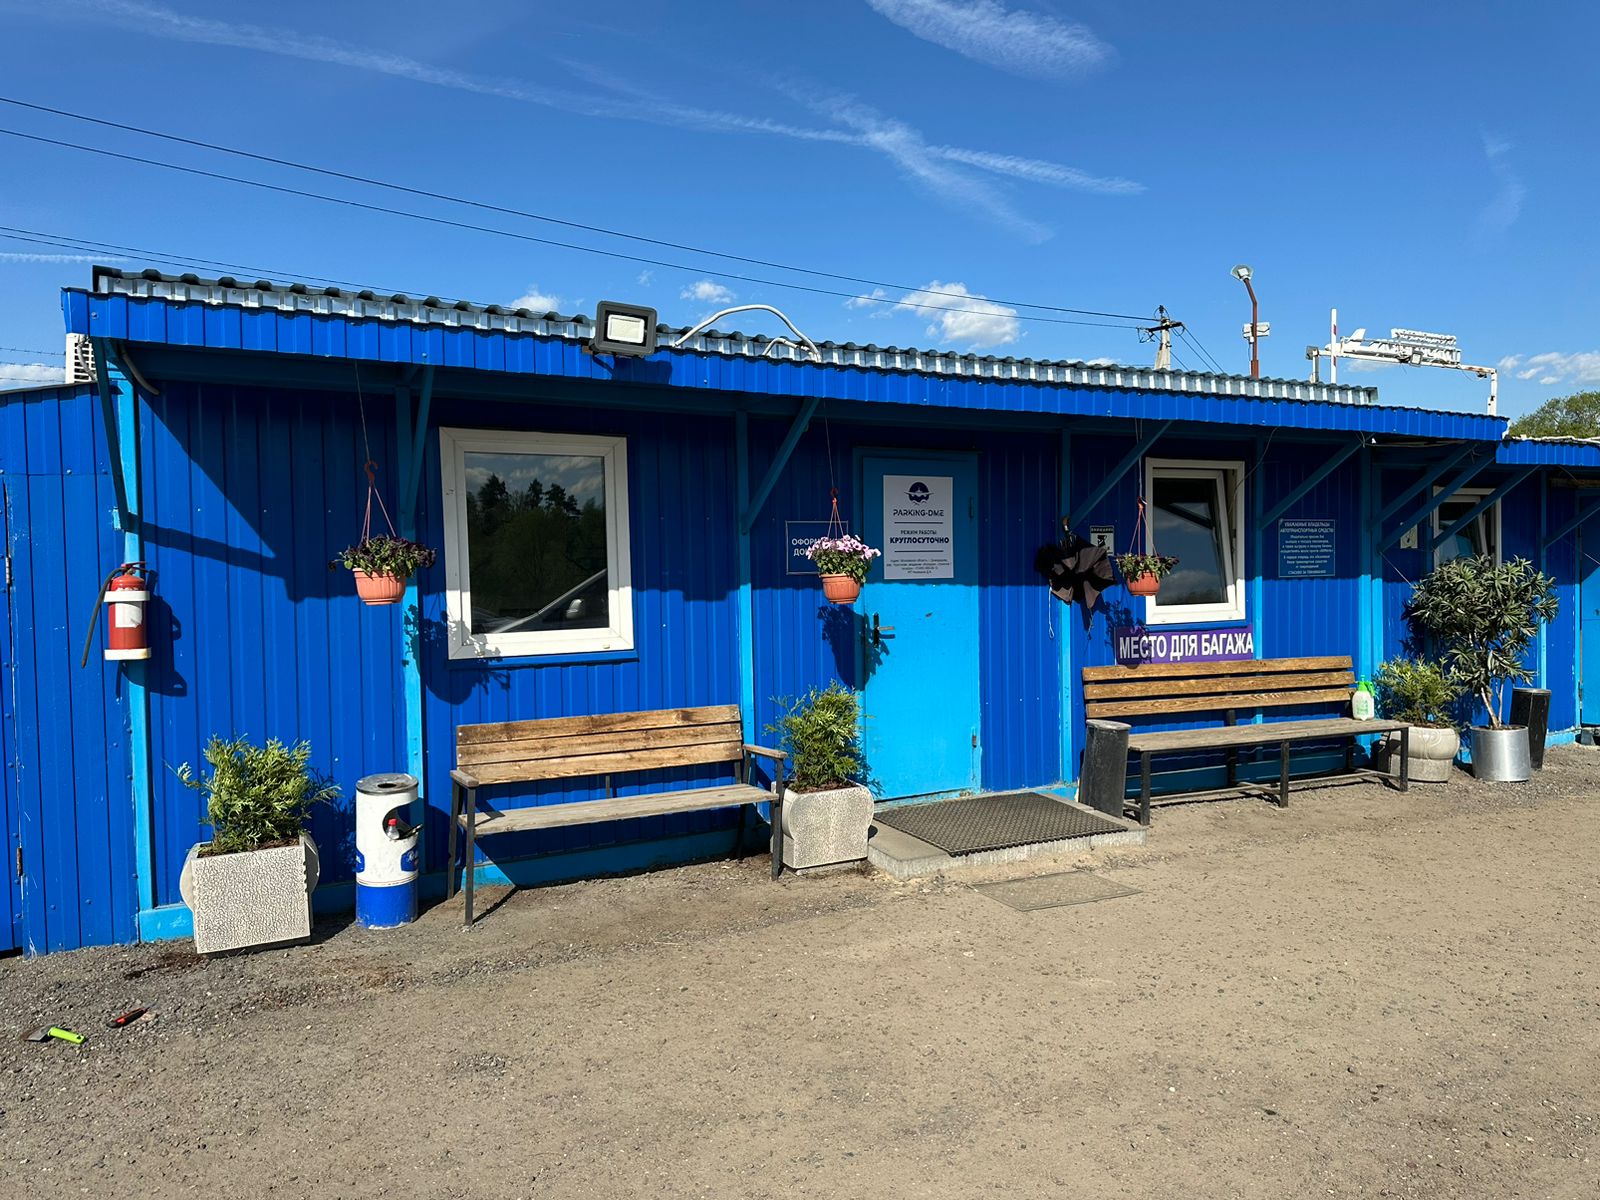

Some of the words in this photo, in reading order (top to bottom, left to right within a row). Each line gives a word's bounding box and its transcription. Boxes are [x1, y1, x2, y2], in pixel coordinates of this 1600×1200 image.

[1119, 635, 1167, 659] МЕСТО
[1170, 634, 1198, 661] ДЛЯ
[1201, 632, 1254, 656] БАГАЖА
